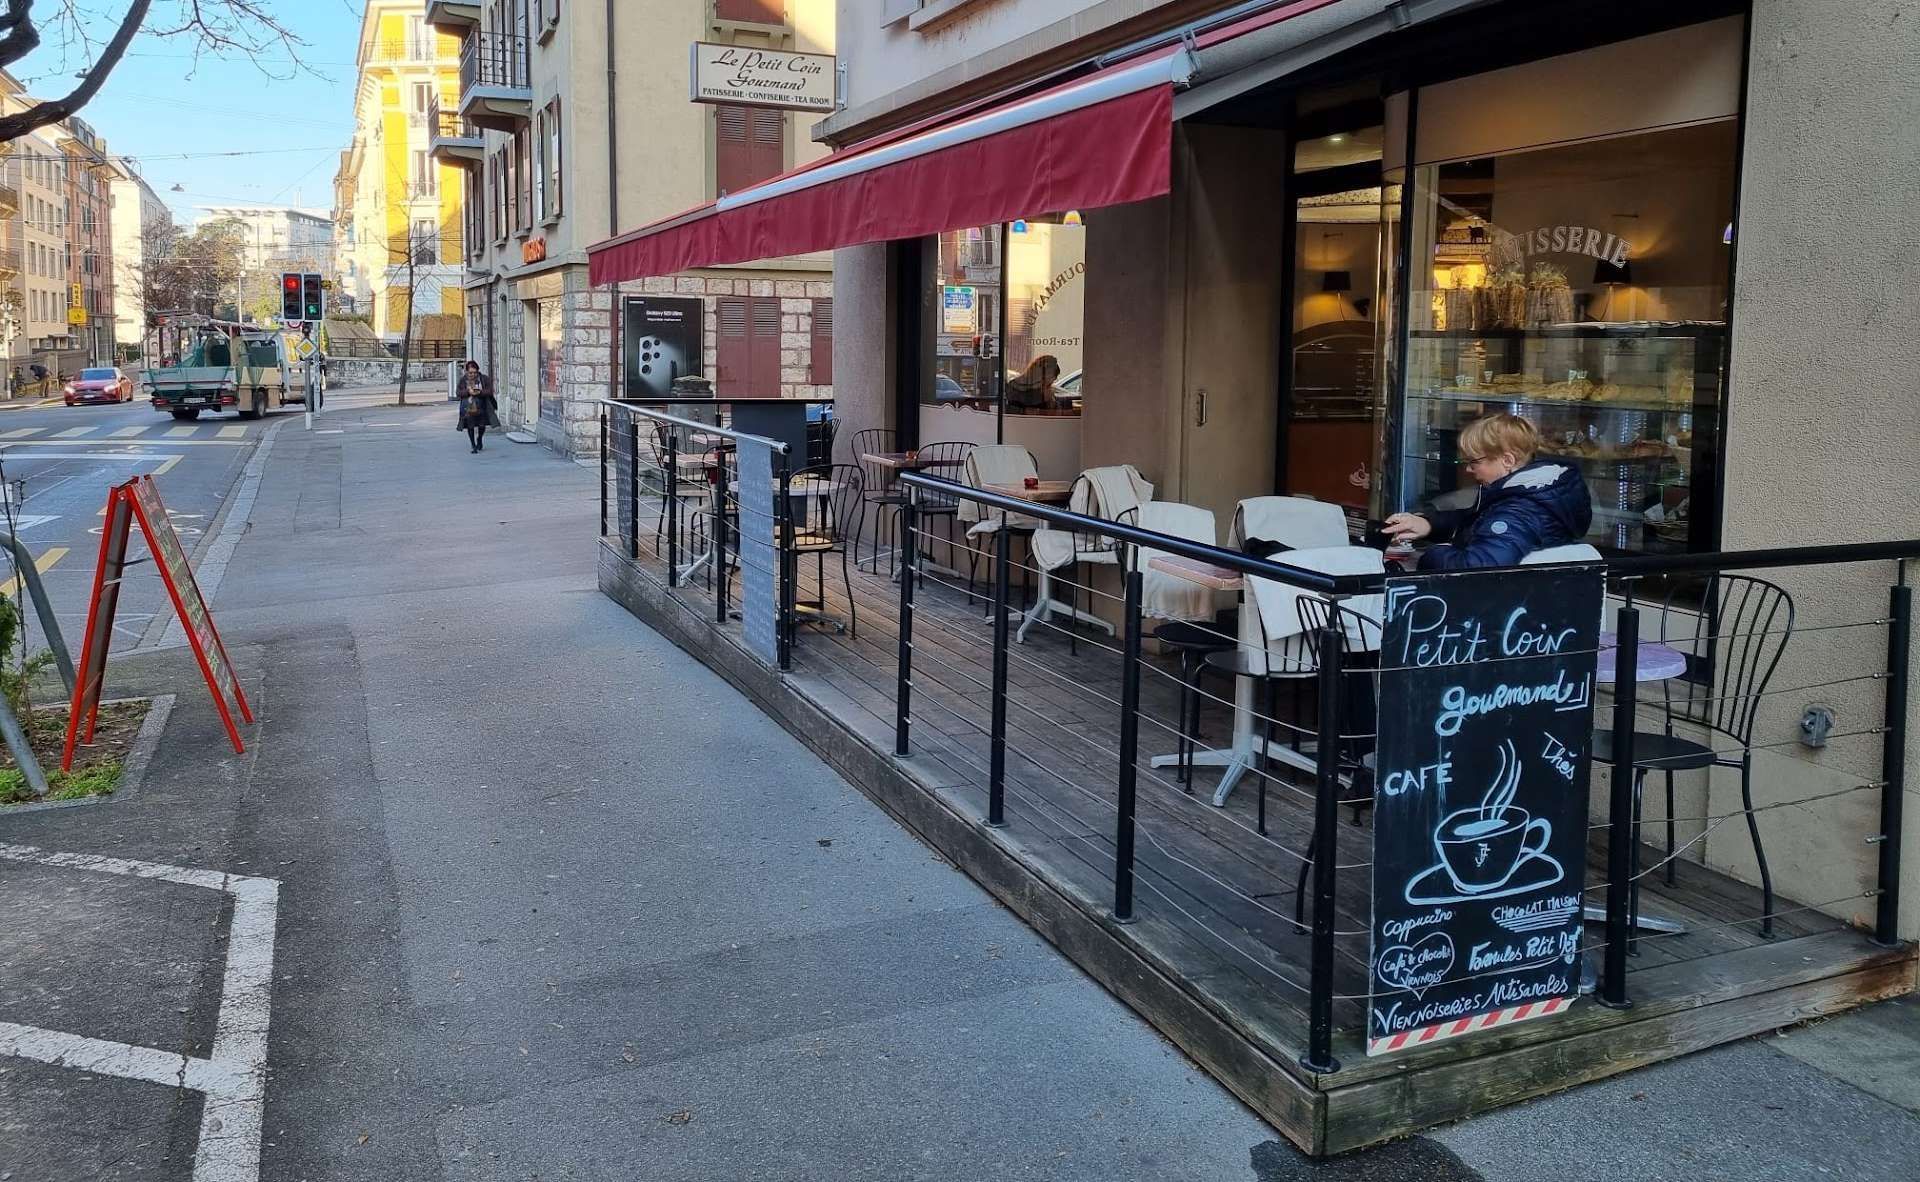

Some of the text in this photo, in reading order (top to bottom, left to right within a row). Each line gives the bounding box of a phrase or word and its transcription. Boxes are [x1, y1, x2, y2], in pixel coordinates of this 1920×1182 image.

[711, 49, 822, 75] Le Petit Coin
[727, 69, 807, 91] Gourmand
[702, 87, 830, 106] PATISSERIE CONFISERIE TEA ROOM
[1402, 595, 1576, 667] Petit Coin
[1384, 752, 1453, 796] CAFÉ
